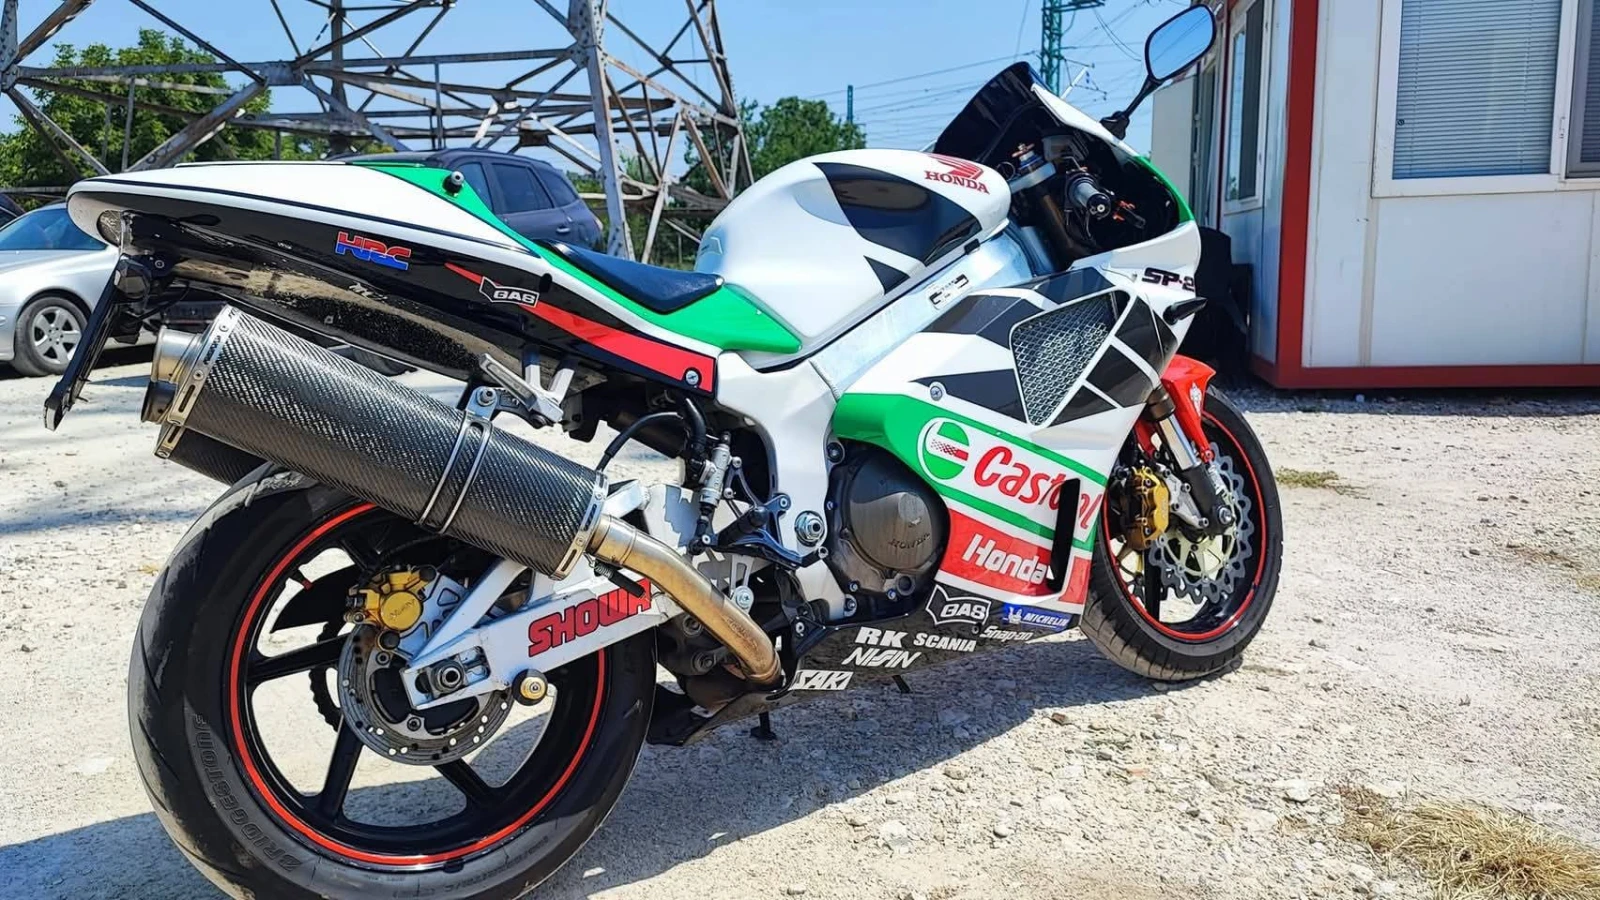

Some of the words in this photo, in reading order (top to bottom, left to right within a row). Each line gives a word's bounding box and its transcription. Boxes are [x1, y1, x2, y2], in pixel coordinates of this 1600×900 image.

[925, 170, 990, 195] HONDA
[335, 231, 412, 271] HRC
[974, 446, 1102, 529] Castl
[962, 533, 1048, 585] Honda
[528, 577, 651, 657] SHOWA
[1023, 612, 1070, 627] MICHELIN
[855, 626, 908, 648] RK
[913, 631, 977, 652] SCANIA
[980, 625, 1034, 643] Snap-on
[192, 713, 302, 873] BRIDGESTONE
